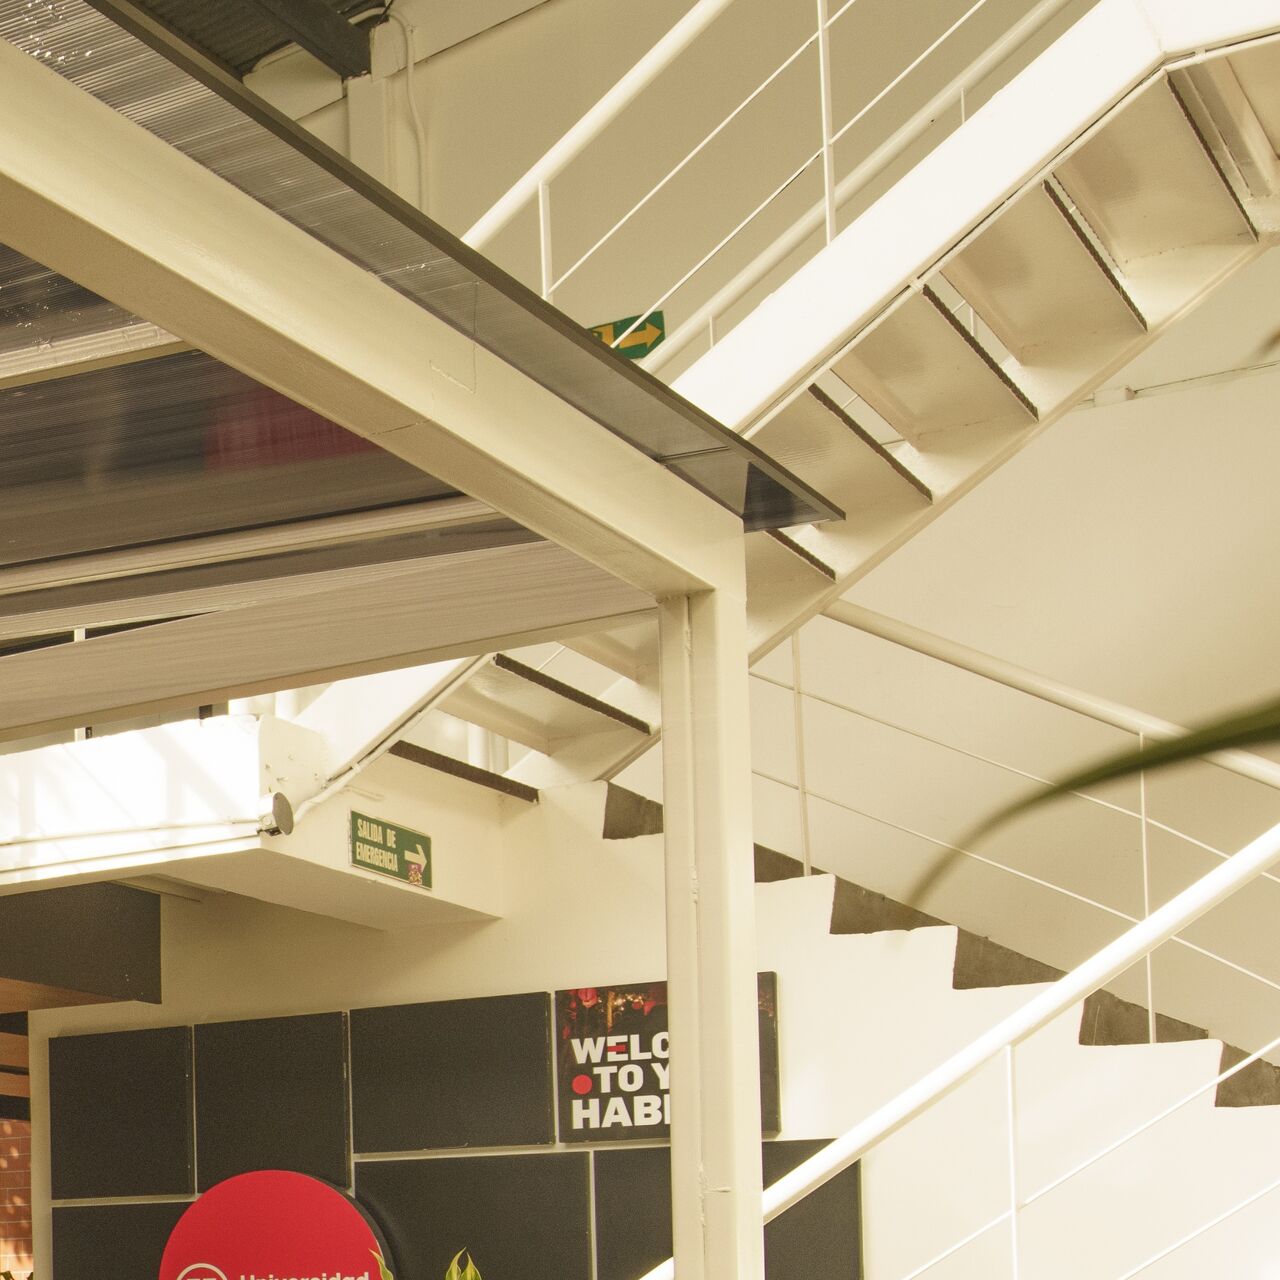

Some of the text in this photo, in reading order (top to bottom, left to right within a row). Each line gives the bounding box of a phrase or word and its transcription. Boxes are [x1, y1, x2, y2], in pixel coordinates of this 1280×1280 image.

[357, 818, 397, 848] SALIDA DE
[355, 841, 399, 872] EMERGENCIA
[593, 1064, 644, 1093] TO
